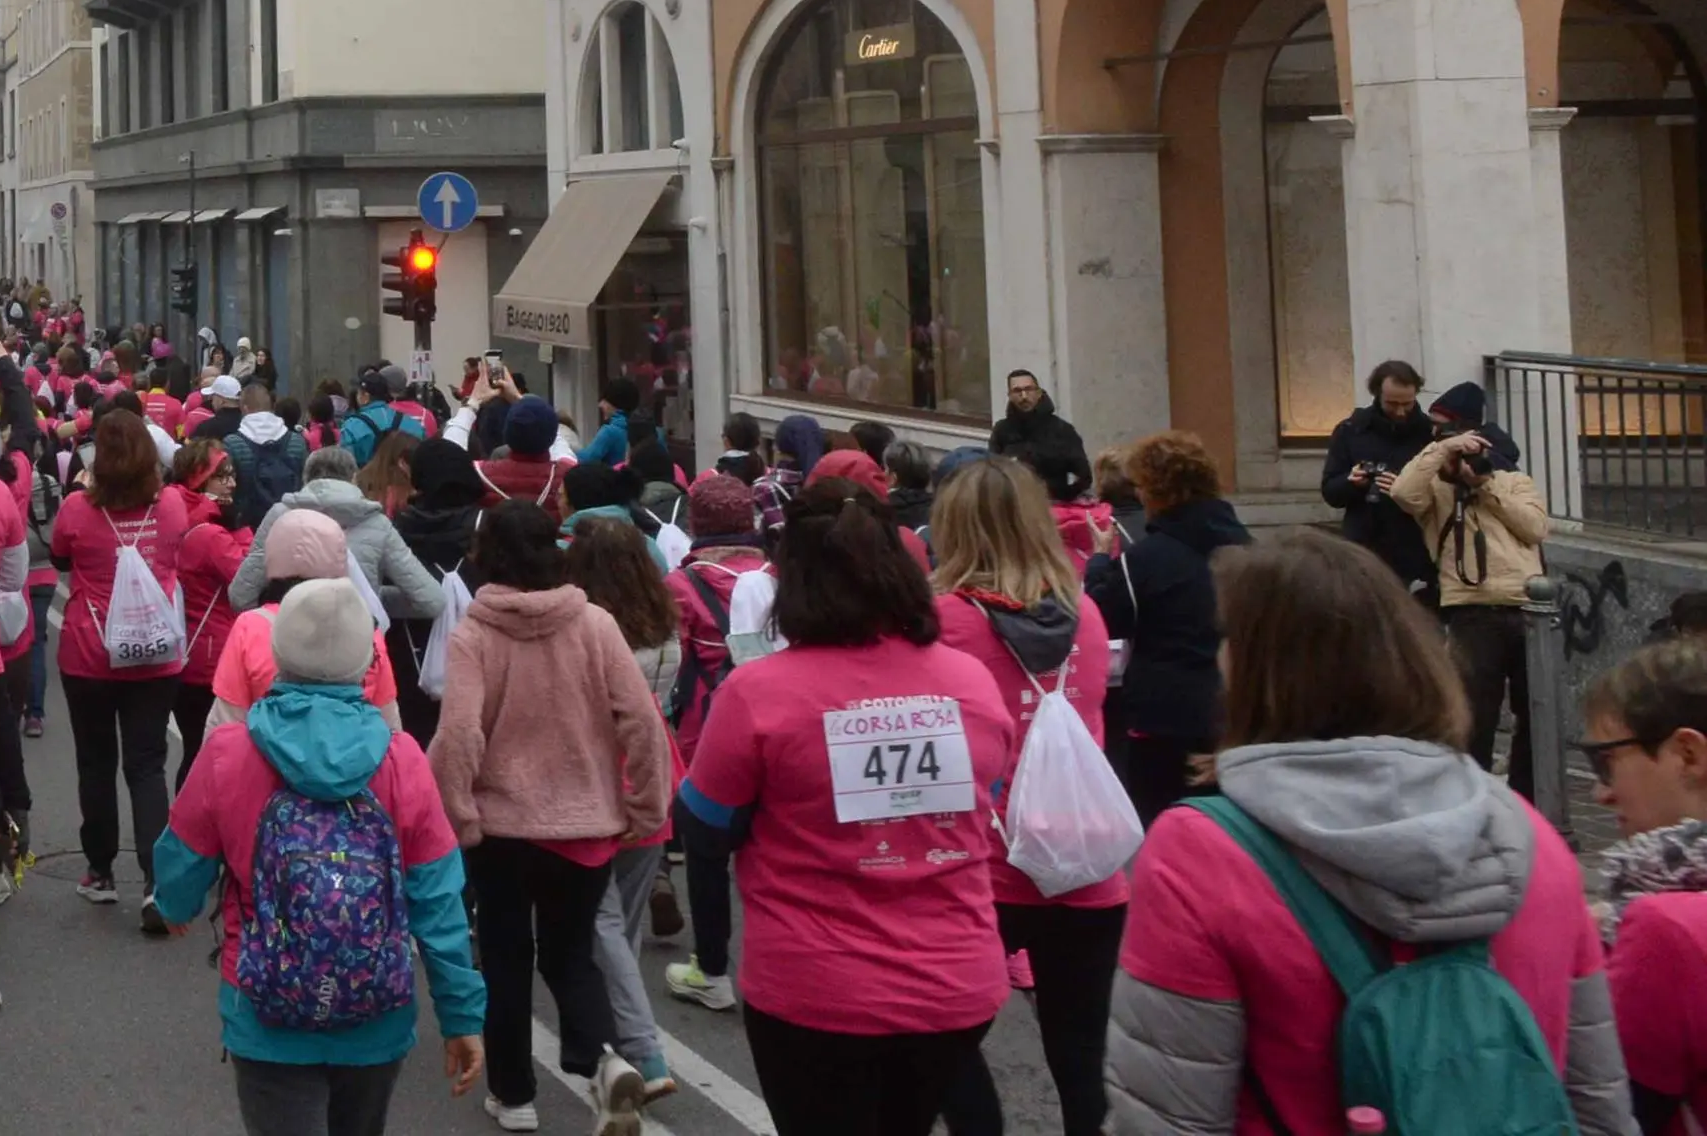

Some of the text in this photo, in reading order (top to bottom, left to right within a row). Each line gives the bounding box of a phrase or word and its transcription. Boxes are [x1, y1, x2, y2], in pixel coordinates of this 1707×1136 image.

[859, 34, 899, 59] Cartier
[118, 637, 169, 660] 3855
[844, 714, 907, 735] CORSA
[864, 741, 941, 786] 474
